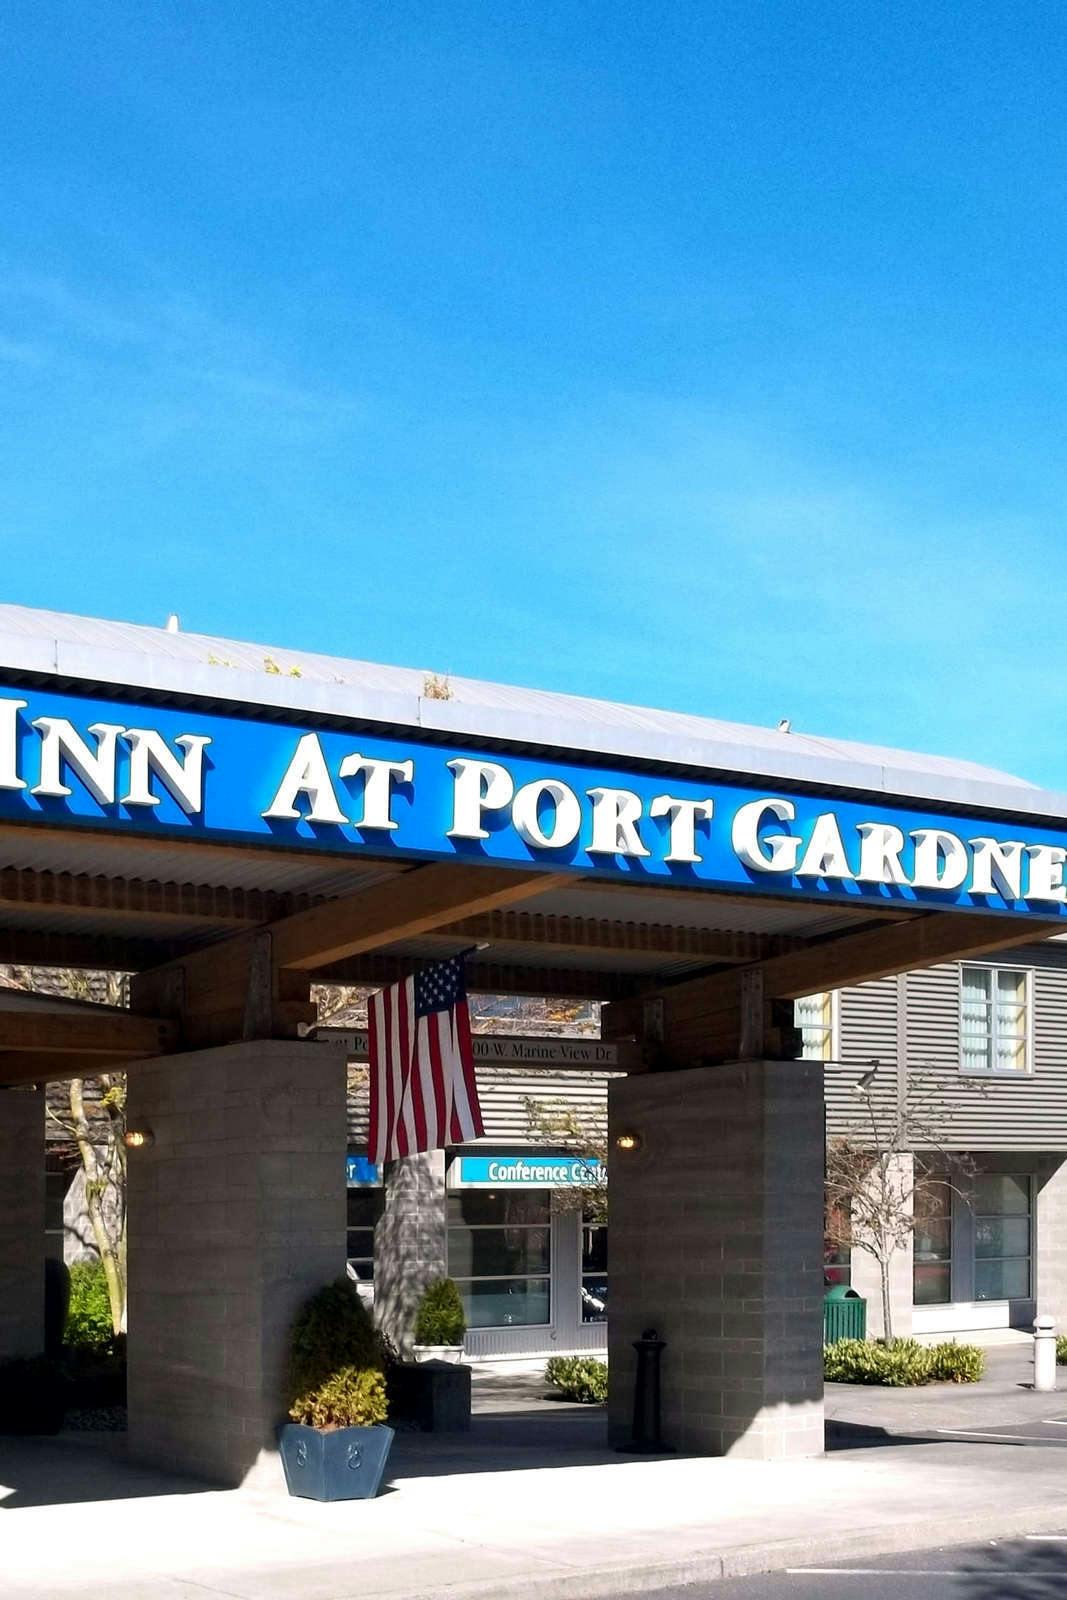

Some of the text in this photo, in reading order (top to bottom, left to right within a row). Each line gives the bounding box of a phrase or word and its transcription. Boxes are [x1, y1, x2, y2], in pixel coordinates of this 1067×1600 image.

[511, 1042, 556, 1059] Marine
[560, 1045, 590, 1060] View
[488, 1161, 568, 1181] Conference
